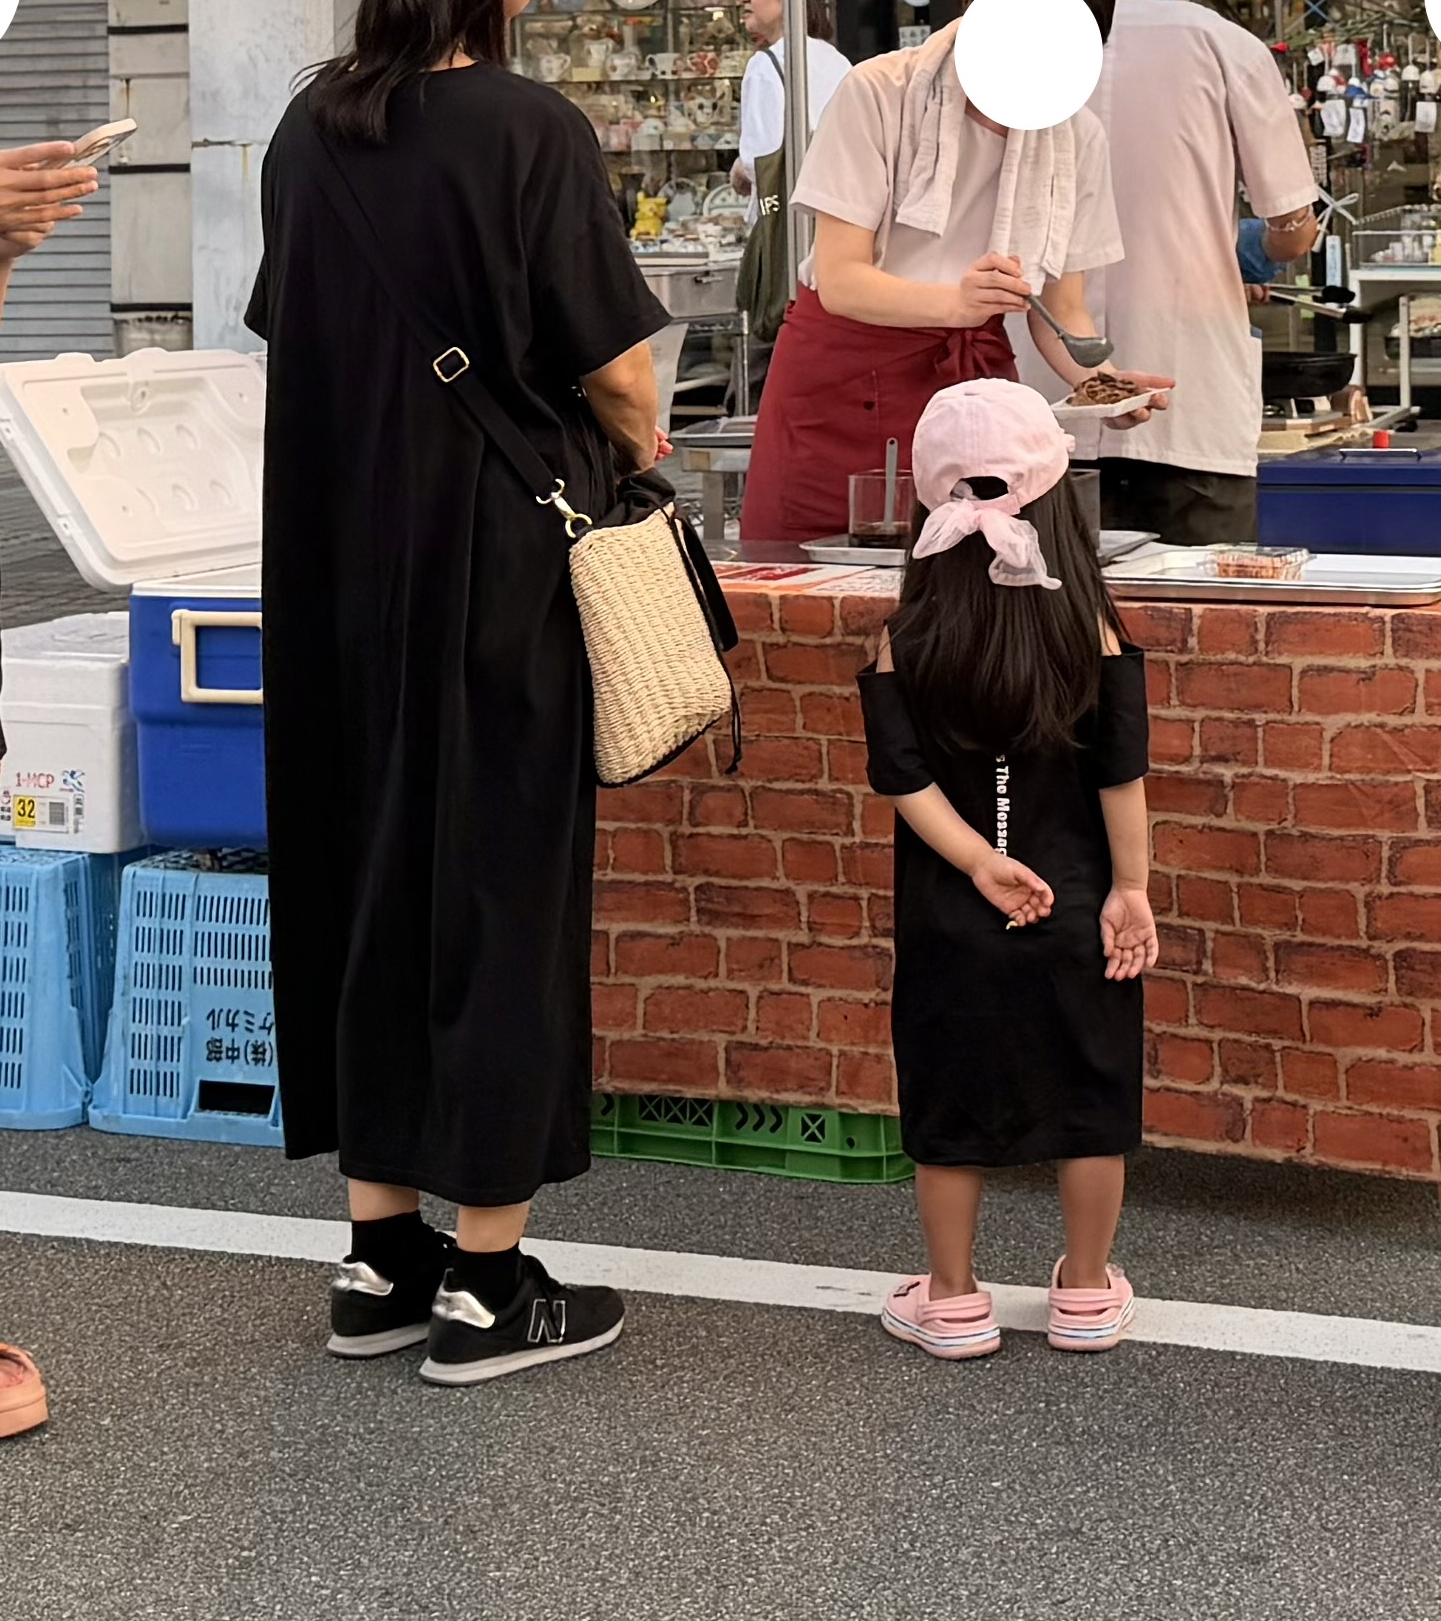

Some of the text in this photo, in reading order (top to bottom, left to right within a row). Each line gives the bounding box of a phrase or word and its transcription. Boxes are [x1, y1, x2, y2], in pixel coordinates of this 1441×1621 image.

[17, 798, 36, 819] 32
[205, 1008, 275, 1036] ケミカル
